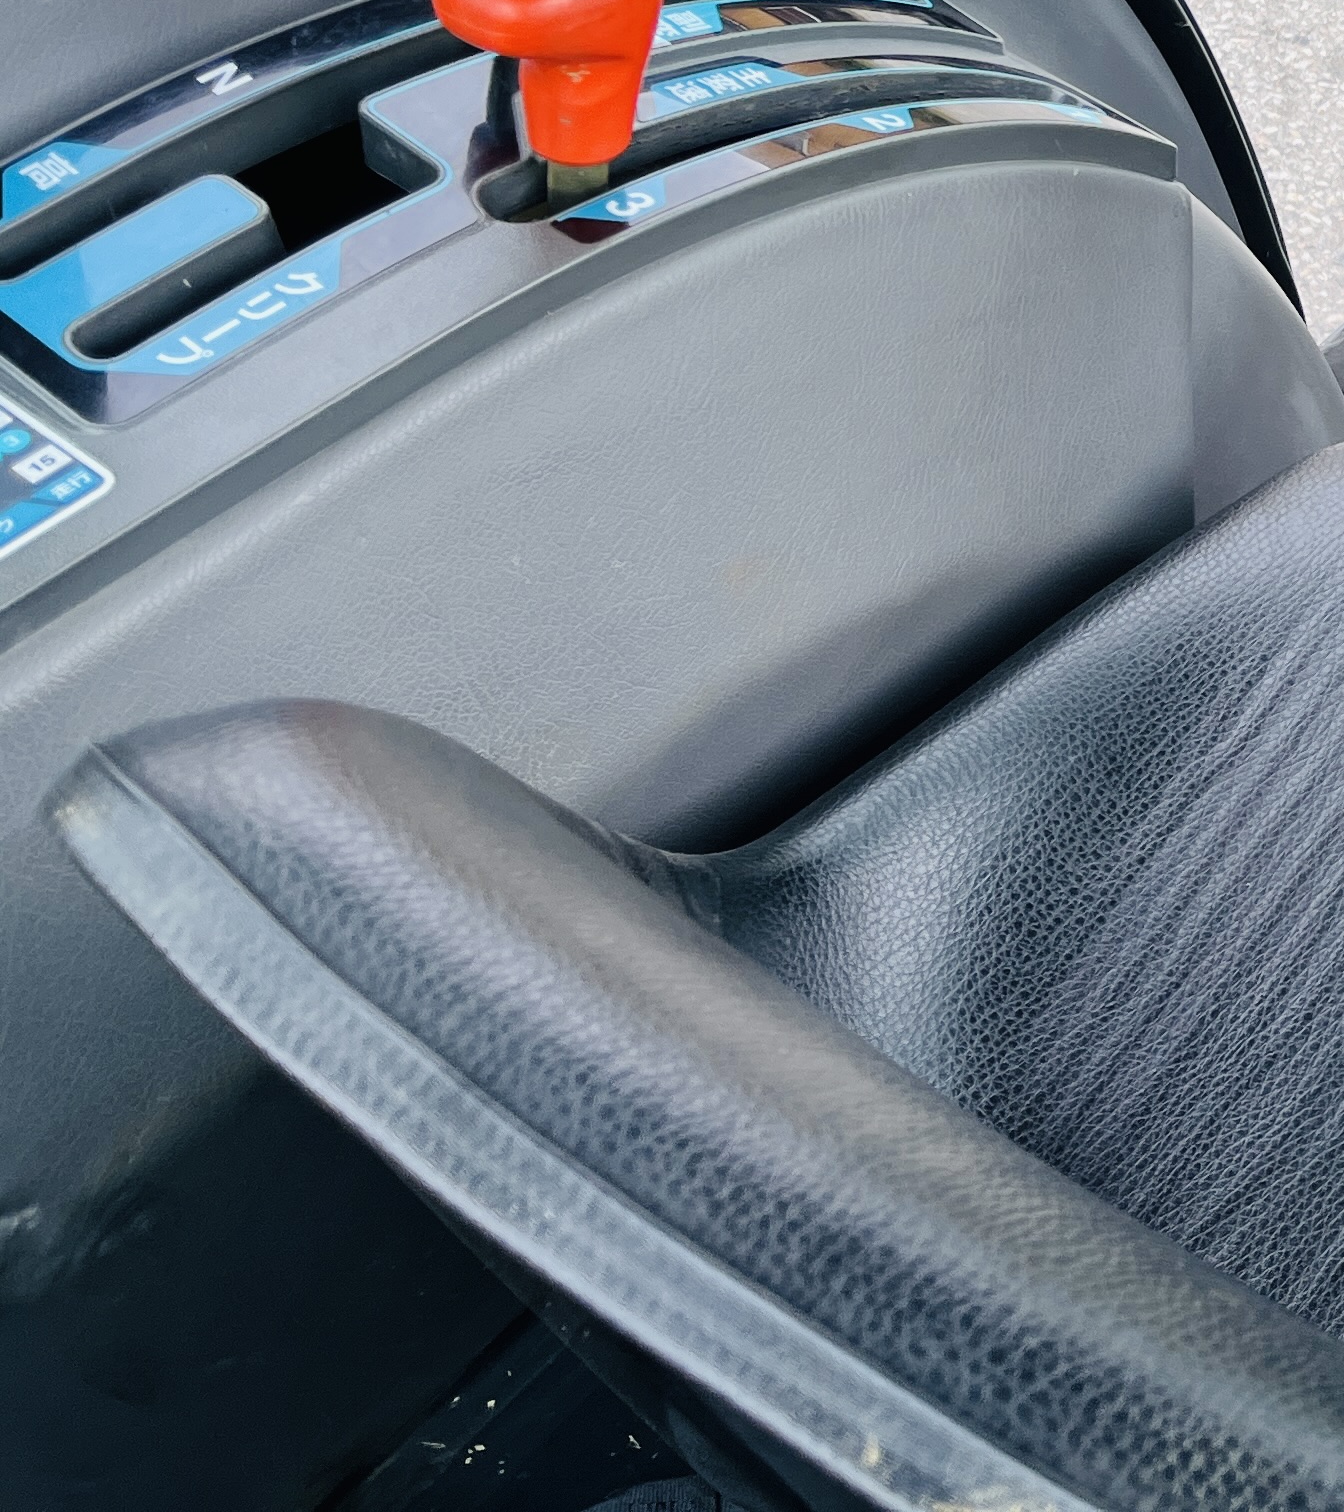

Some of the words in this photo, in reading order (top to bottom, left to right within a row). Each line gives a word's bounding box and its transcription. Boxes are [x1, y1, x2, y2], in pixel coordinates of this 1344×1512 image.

[196, 61, 253, 96] N
[873, 112, 908, 134] 2
[605, 192, 656, 217] 3
[155, 271, 325, 366] クリープ
[28, 454, 57, 472] 15
